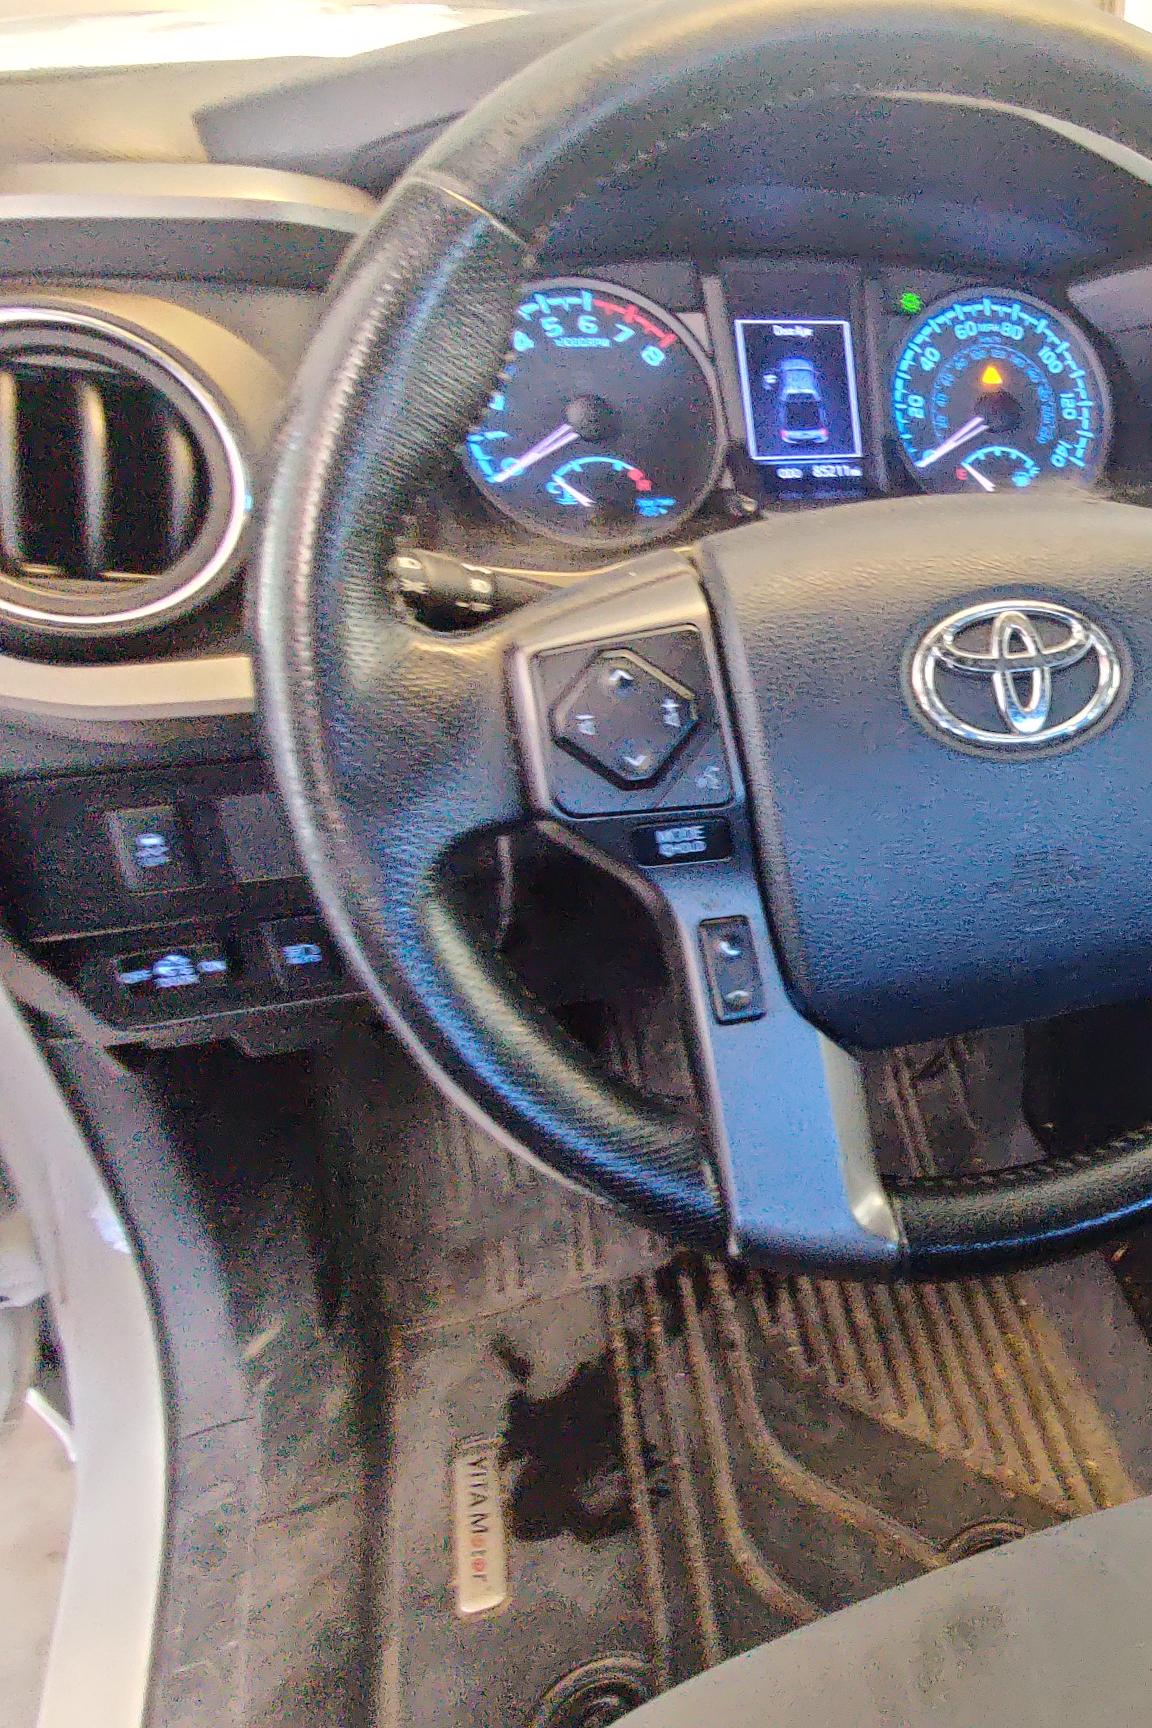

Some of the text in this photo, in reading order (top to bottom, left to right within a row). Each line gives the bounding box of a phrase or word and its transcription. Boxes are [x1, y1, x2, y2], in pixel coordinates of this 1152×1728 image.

[540, 316, 563, 338] 5
[577, 315, 598, 334] 6
[613, 323, 636, 343] 7
[955, 321, 977, 340] 60
[1000, 321, 1024, 341] 80
[513, 330, 535, 352] 4
[920, 346, 941, 371] 40
[1038, 345, 1063, 374] 100
[956, 467, 968, 481] E
